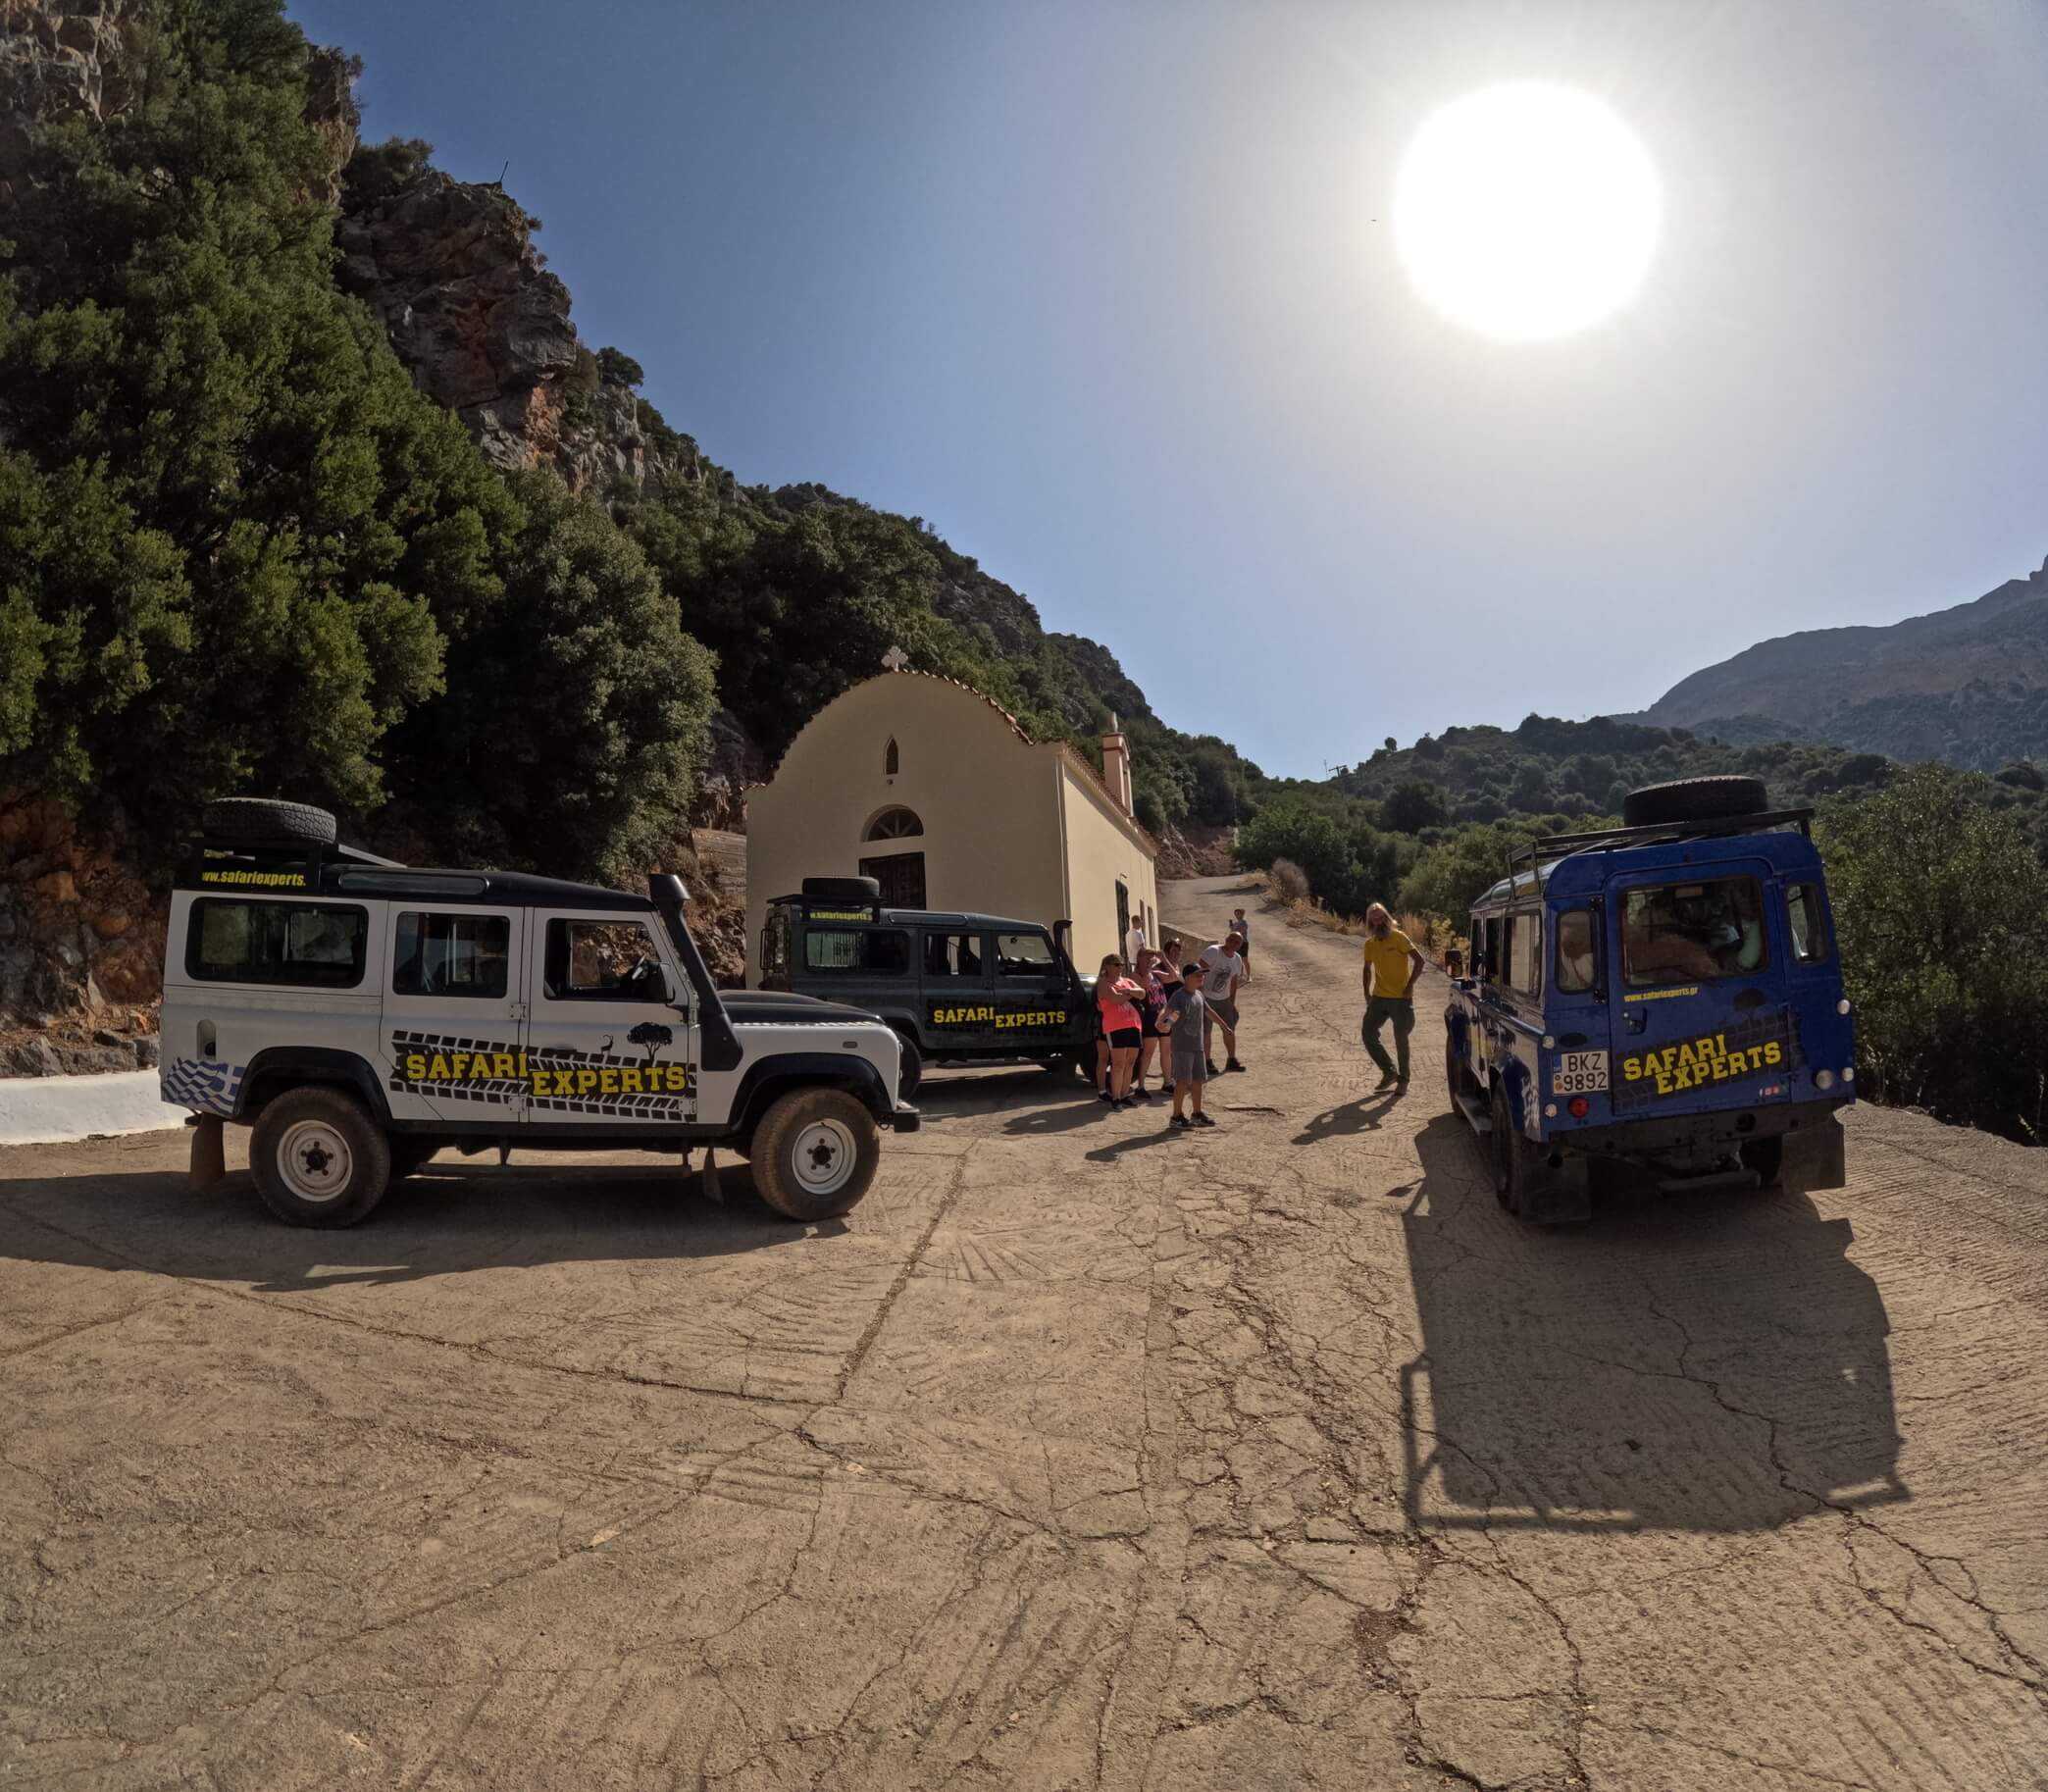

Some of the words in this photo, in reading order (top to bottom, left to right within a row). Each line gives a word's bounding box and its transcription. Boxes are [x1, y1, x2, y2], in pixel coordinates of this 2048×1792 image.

[1624, 987, 1699, 1002] www.safariexperts.gr
[934, 1006, 995, 1023] SAFARI
[995, 1011, 1066, 1028] EXPERTS
[1567, 1052, 1602, 1073] BKZ
[1623, 1034, 1727, 1081] SAFARI
[1655, 1042, 1781, 1095] EXPERTS
[406, 1052, 529, 1079] SAFARI
[533, 1066, 687, 1096] EXPERTS
[1563, 1071, 1608, 1092] 9892
